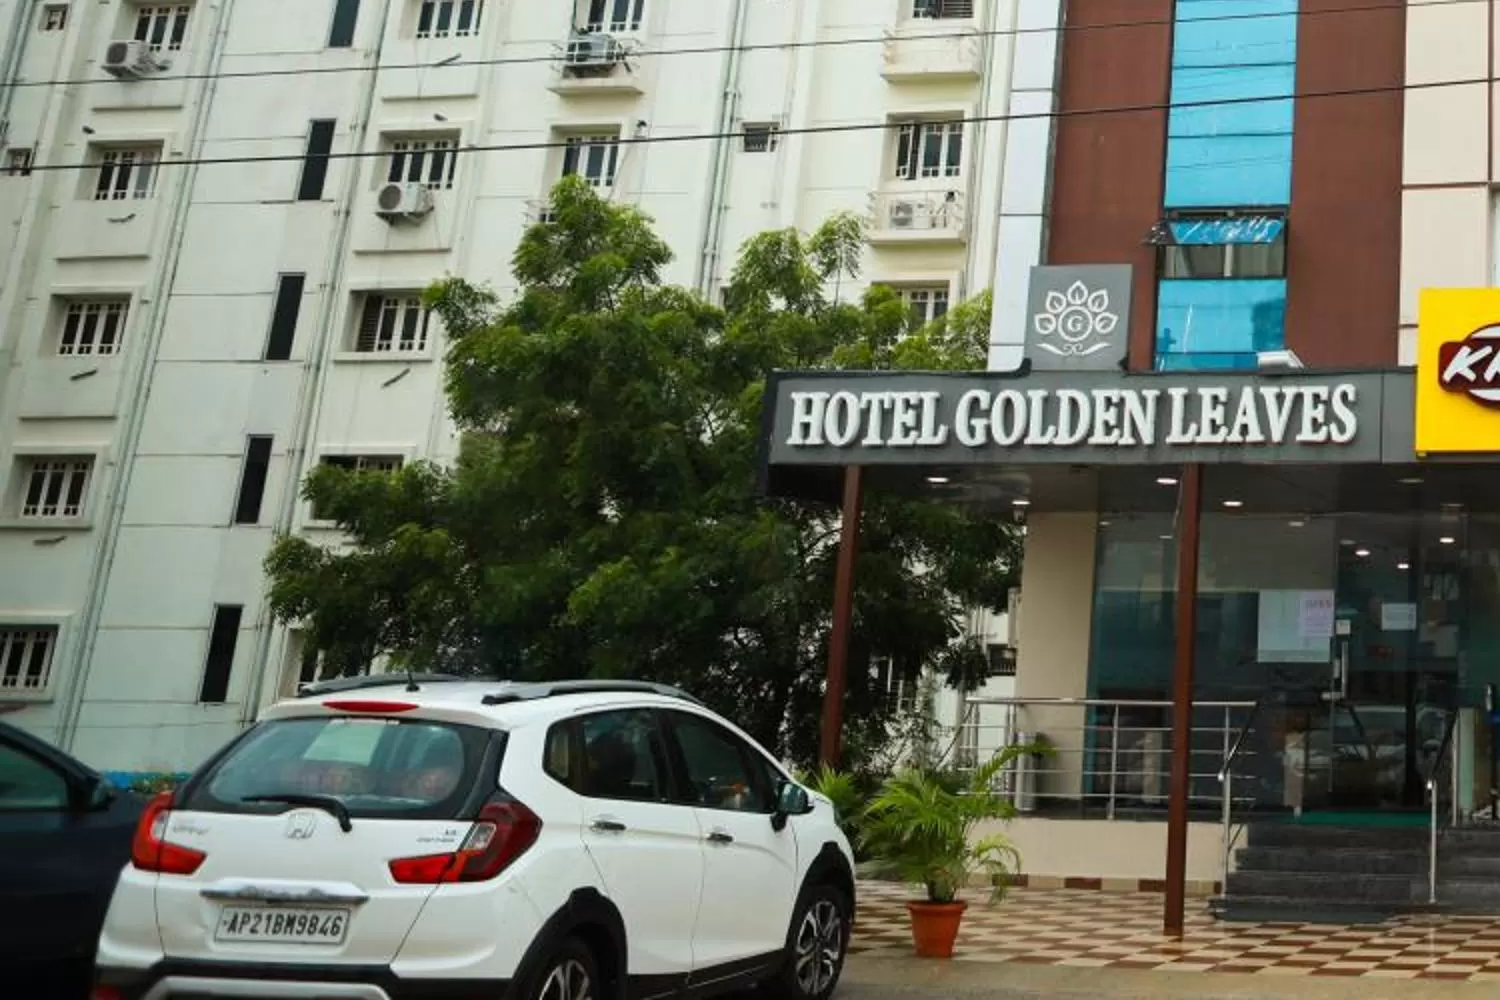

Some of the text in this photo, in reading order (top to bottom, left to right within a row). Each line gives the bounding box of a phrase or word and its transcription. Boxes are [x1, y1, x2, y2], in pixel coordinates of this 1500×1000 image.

[786, 383, 1358, 447] HOTEL GOLDEN LEAVES
